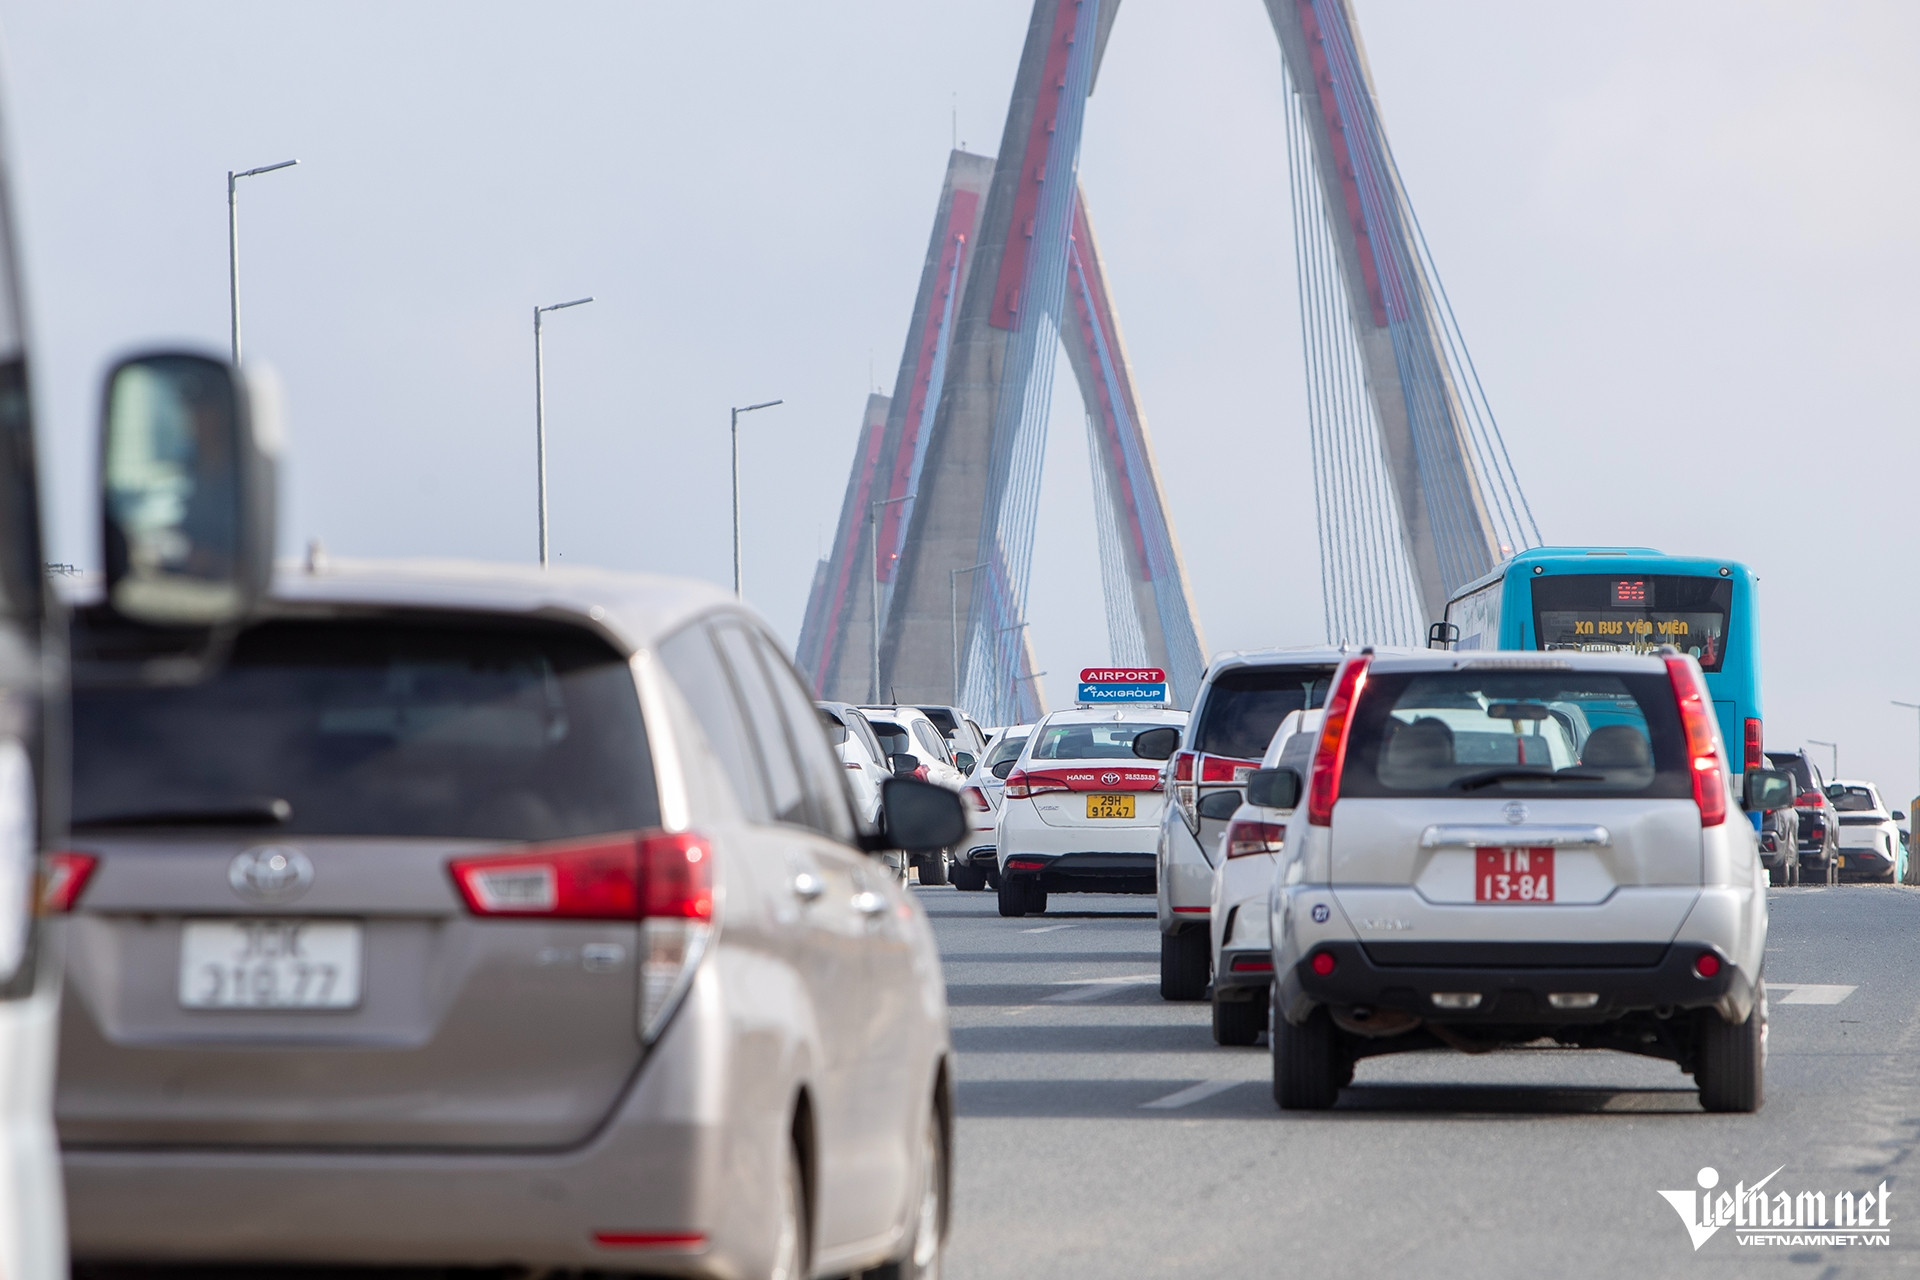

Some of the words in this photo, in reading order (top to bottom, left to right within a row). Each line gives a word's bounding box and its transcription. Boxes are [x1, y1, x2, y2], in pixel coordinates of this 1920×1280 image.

[1598, 621, 1623, 634] BUS
[1086, 671, 1159, 681] AIRPORT
[1100, 796, 1121, 806] 29H
[1091, 807, 1130, 817] 912.47
[1501, 848, 1530, 873] TN
[1484, 874, 1549, 900] 13-84
